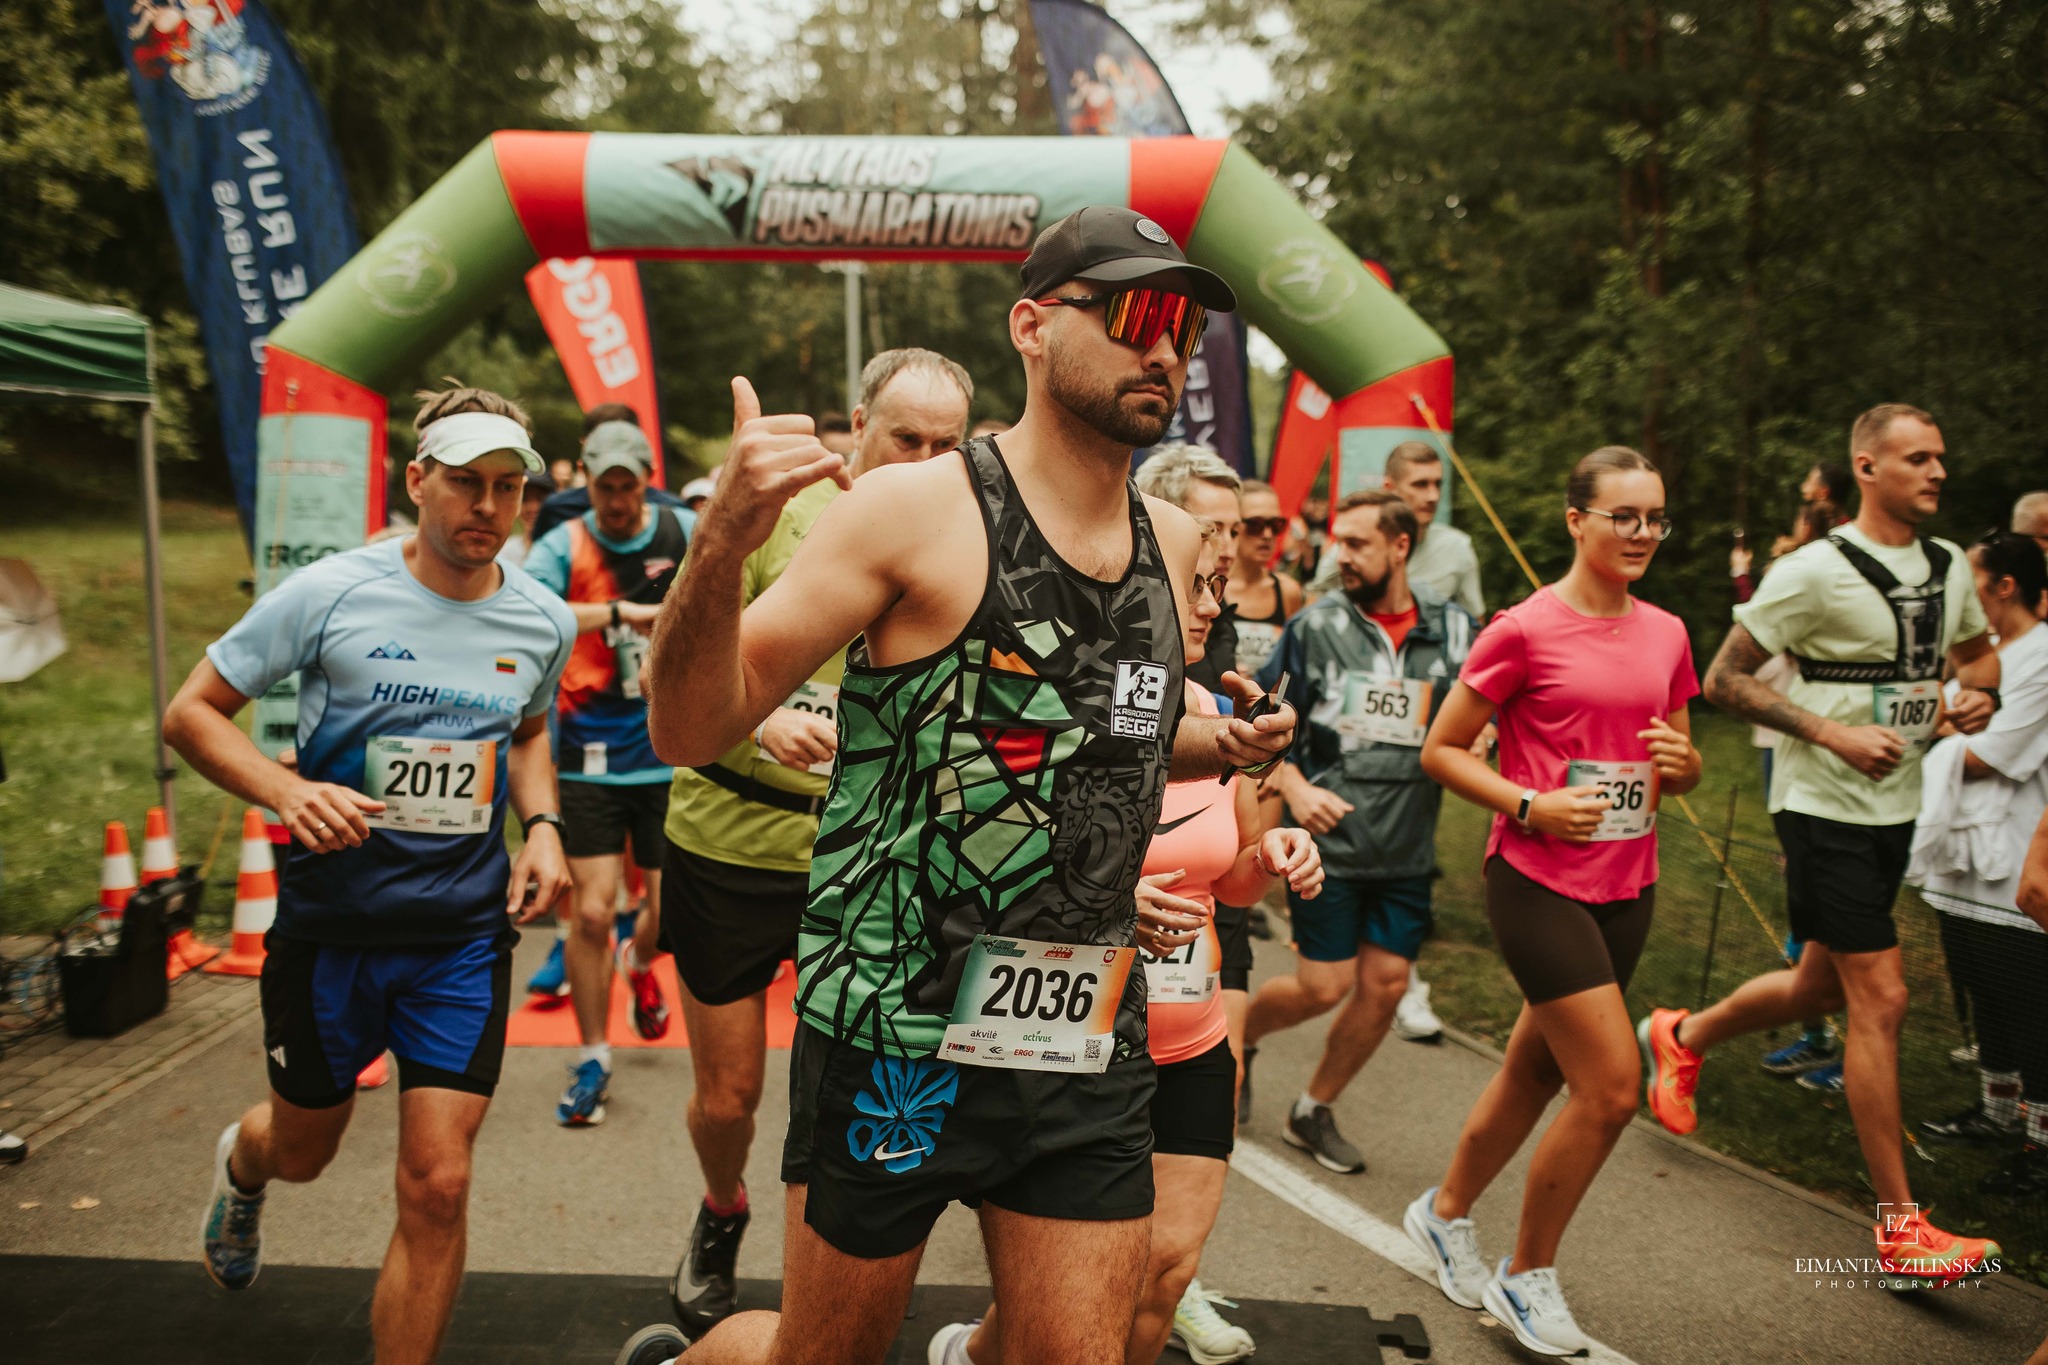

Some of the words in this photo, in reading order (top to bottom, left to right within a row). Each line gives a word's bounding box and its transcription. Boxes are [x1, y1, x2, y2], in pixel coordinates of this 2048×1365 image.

[771, 143, 935, 188] ALYTAUS
[755, 190, 1038, 246] PUSMARATONIS
[372, 682, 517, 715] HIGHPEAKS
[1115, 664, 1166, 710] KB
[1365, 691, 1409, 719] 563
[1890, 699, 1938, 727] 1087
[384, 760, 476, 798] 2012
[1051, 945, 1074, 953] 2025
[980, 964, 1098, 1023] 2036
[970, 1029, 997, 1040] akvilė
[1023, 1031, 1051, 1043] activus
[1014, 1049, 1034, 1057] ERGO
